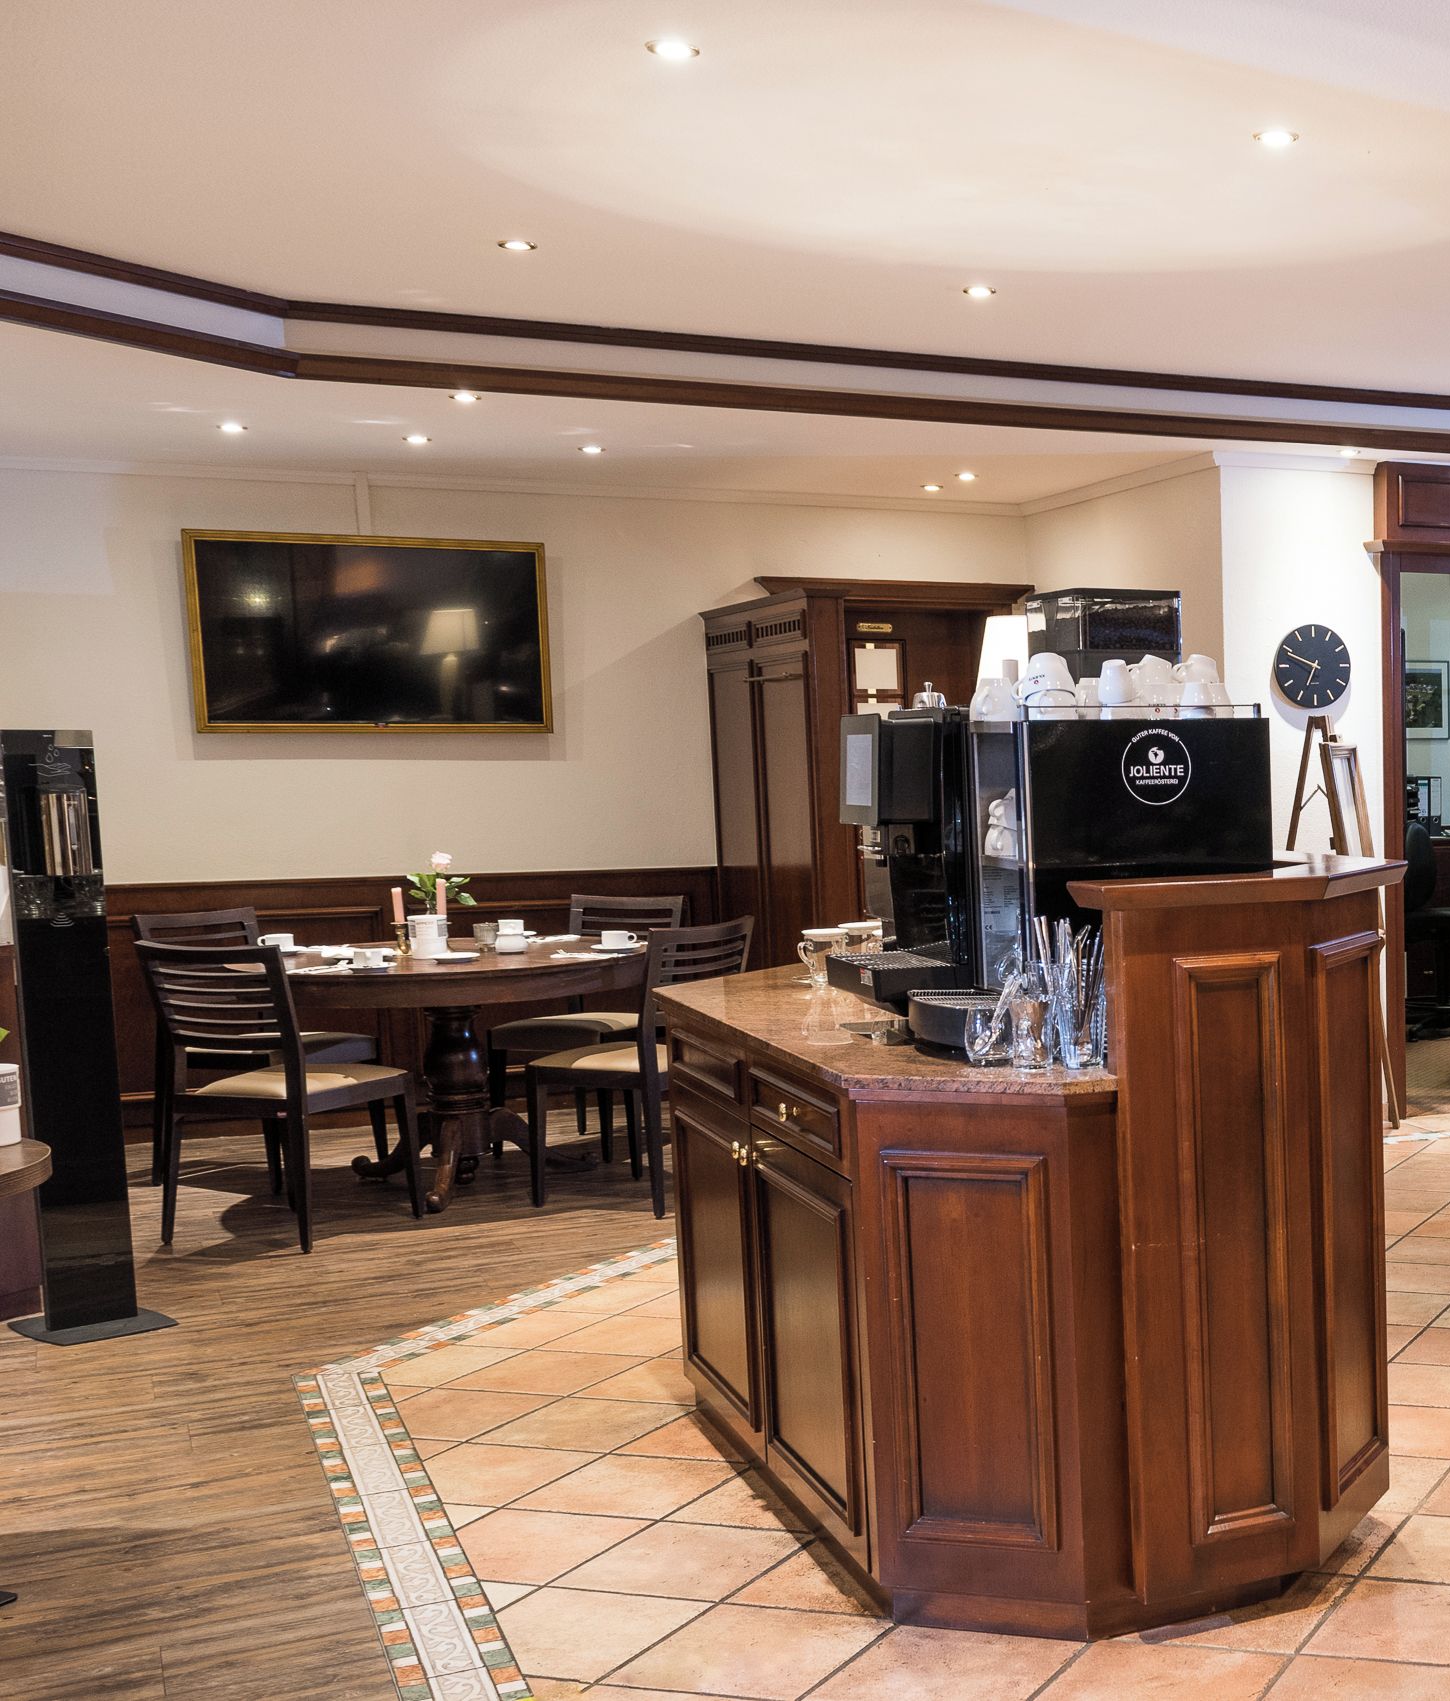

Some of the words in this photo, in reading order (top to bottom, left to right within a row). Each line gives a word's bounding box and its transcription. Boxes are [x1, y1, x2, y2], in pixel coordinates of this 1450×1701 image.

[1131, 730, 1149, 743] GUTER
[1148, 728, 1168, 737] KAFFEE
[1168, 731, 1180, 742] VON
[1129, 765, 1184, 777] JOLIENTE
